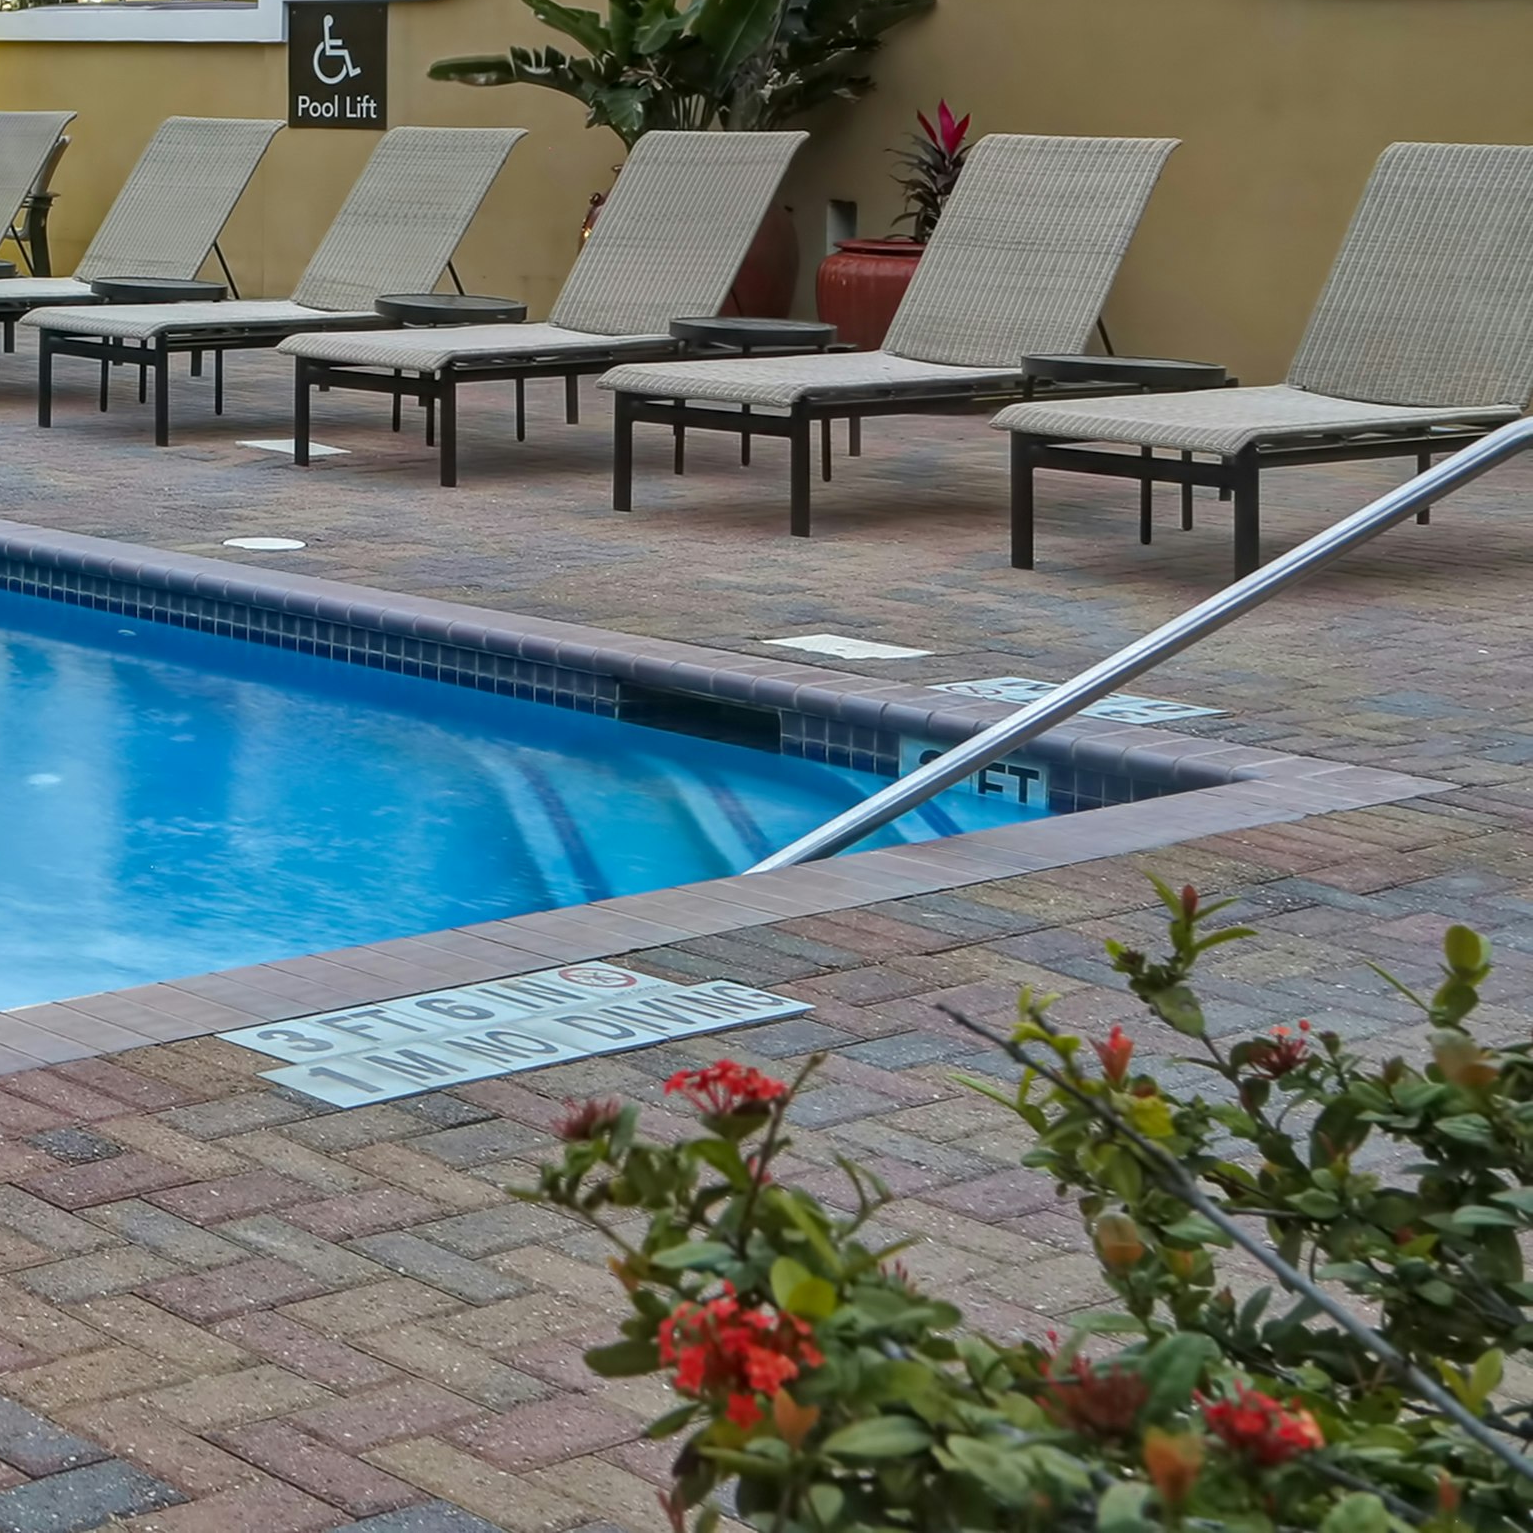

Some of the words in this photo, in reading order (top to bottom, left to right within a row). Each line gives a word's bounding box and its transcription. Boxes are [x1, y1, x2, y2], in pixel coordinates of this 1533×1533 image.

[297, 94, 338, 117] Pool
[346, 94, 377, 118] Lift
[978, 761, 1040, 804] FT
[256, 1029, 334, 1052] 3
[317, 1008, 427, 1041] FT
[415, 998, 495, 1020] 6
[478, 980, 587, 1009] IN
[308, 1066, 385, 1094] 1
[364, 1049, 468, 1080] M
[444, 1030, 559, 1064] NO
[552, 985, 785, 1040] DIVING
